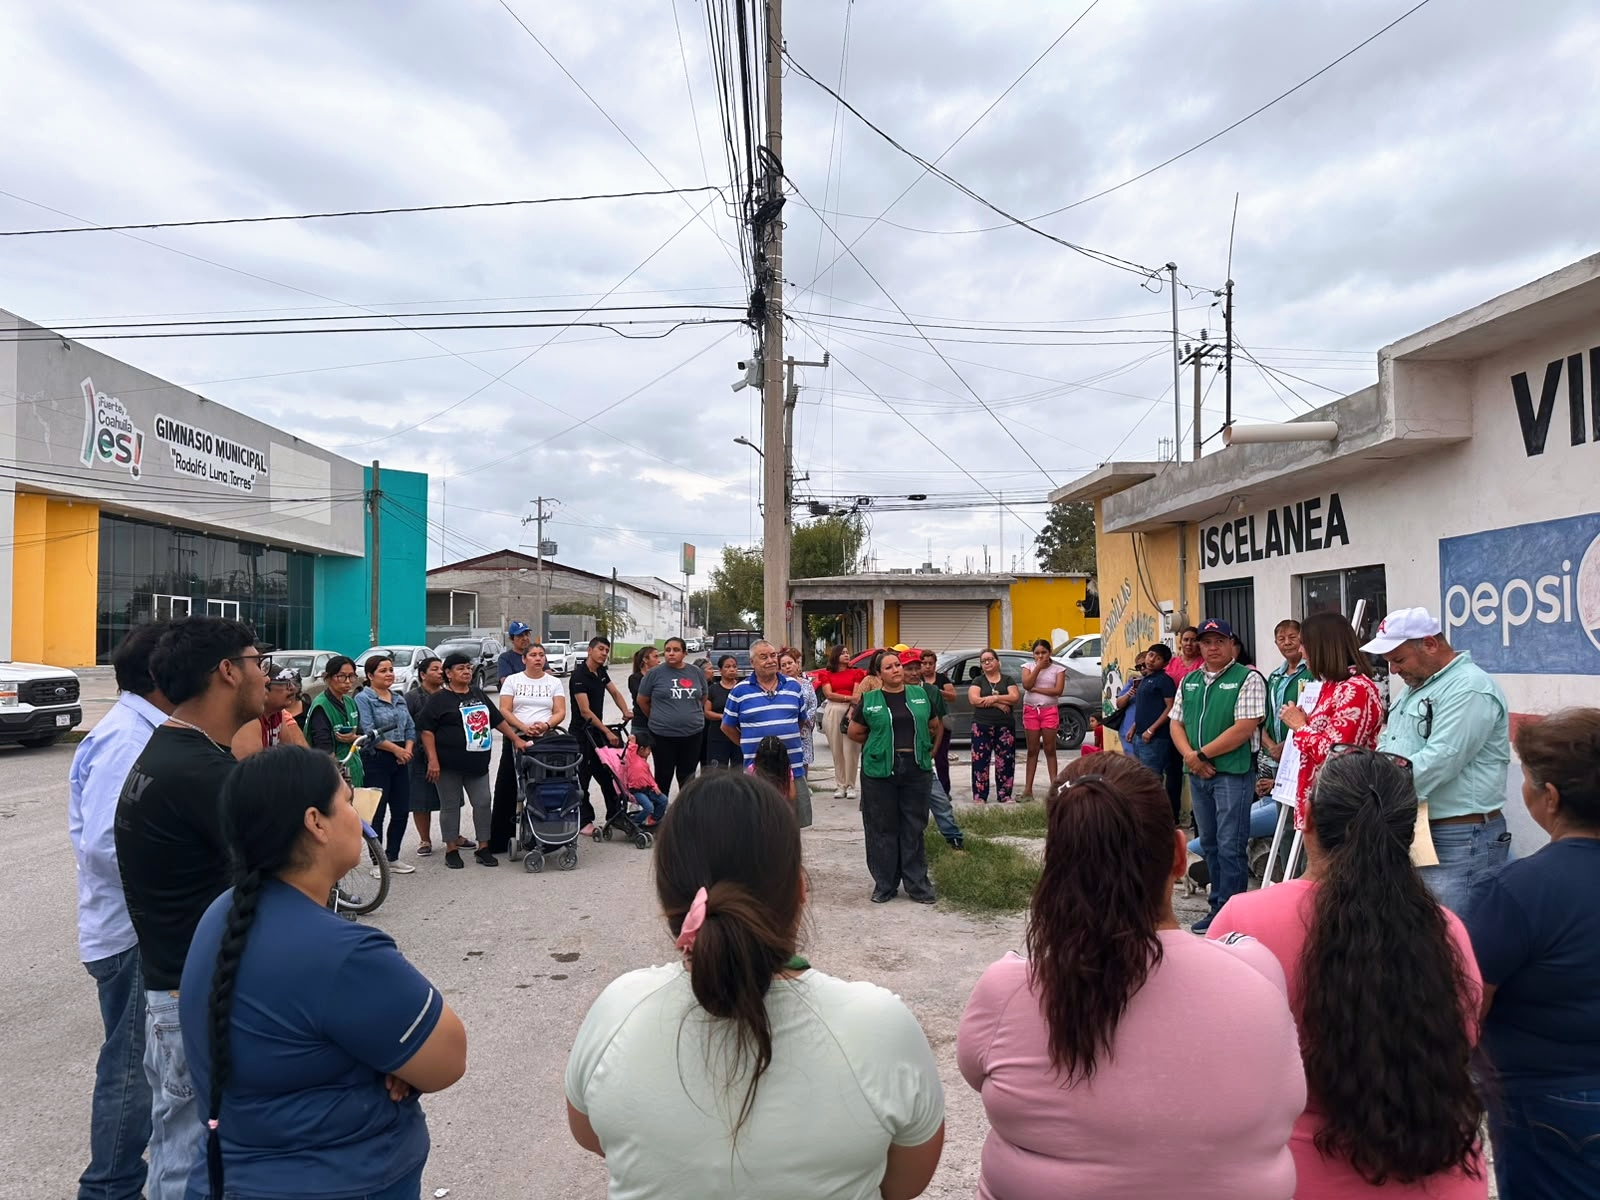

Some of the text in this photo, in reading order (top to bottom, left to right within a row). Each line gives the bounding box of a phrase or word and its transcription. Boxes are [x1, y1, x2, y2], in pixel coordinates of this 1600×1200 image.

[98, 409, 133, 433] Coahuila
[156, 417, 267, 473] GIMNASIO MUNICIPAL
[209, 463, 228, 483] Luna
[1199, 493, 1350, 570] ISCELANEA
[1445, 559, 1572, 647] pepsi
[670, 688, 697, 699] NY
[671, 678, 680, 688] I
